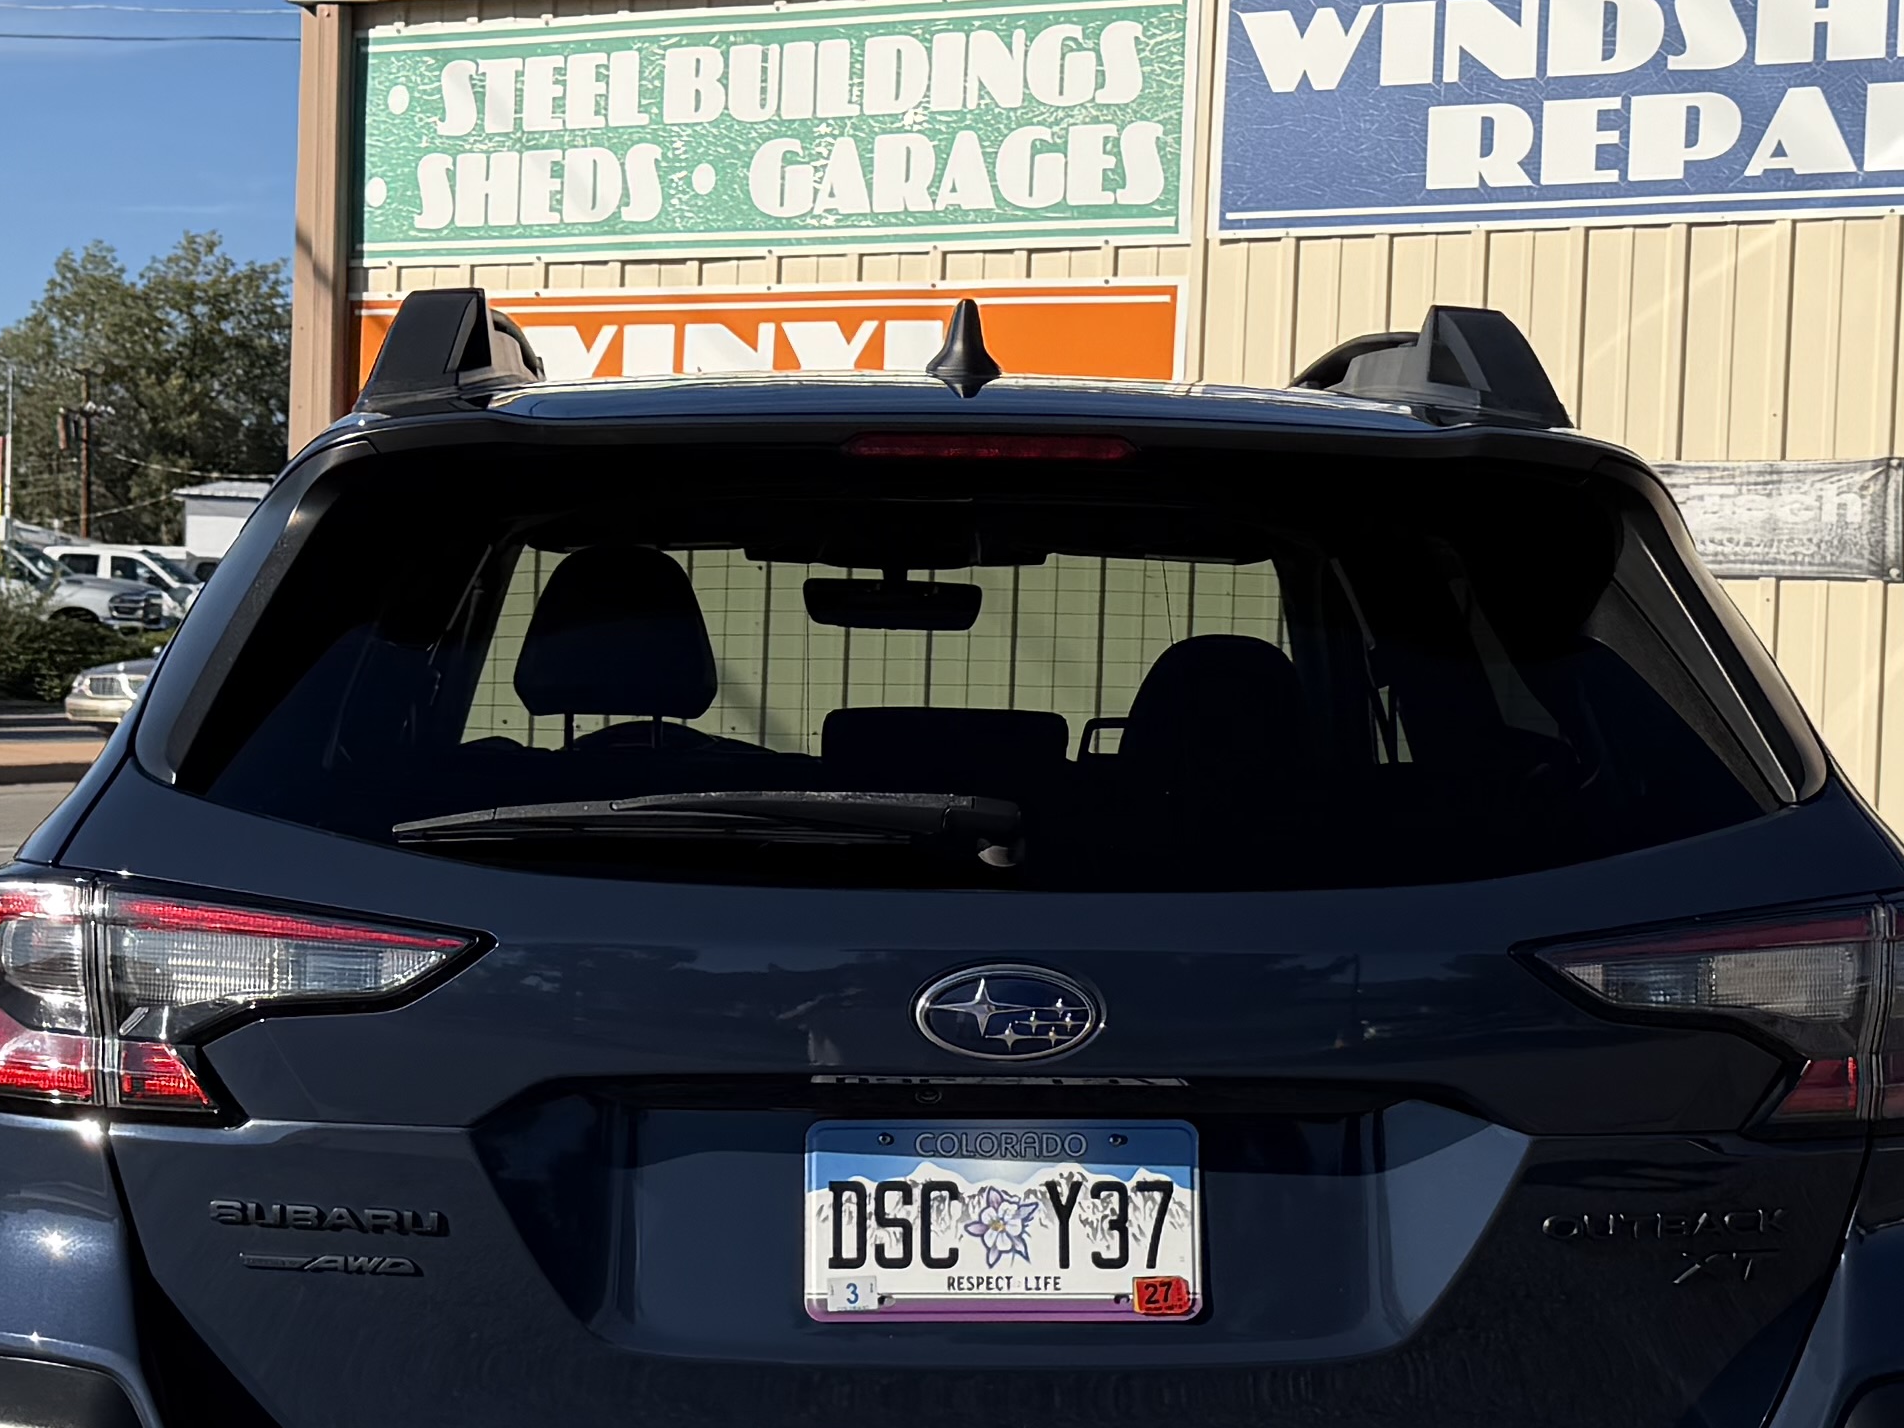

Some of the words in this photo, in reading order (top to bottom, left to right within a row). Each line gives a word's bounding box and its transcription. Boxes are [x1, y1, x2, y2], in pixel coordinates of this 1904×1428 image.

[437, 50, 650, 137] STEEL
[662, 20, 1144, 125] BUILDINGS
[413, 143, 664, 230] SHEDS
[748, 121, 1165, 219] GARAGES
[915, 1132, 1088, 1158] COLORADO
[209, 1200, 442, 1236] SUBARU
[828, 1181, 959, 1269] DSC
[1046, 1180, 1174, 1269] Y37
[1542, 1208, 1786, 1240] OUTBACK
[303, 1254, 421, 1275] AWD
[846, 1282, 859, 1304] 3
[947, 1275, 1012, 1291] RESPECT
[1024, 1275, 1062, 1291] LIFE
[1144, 1281, 1173, 1305] 27
